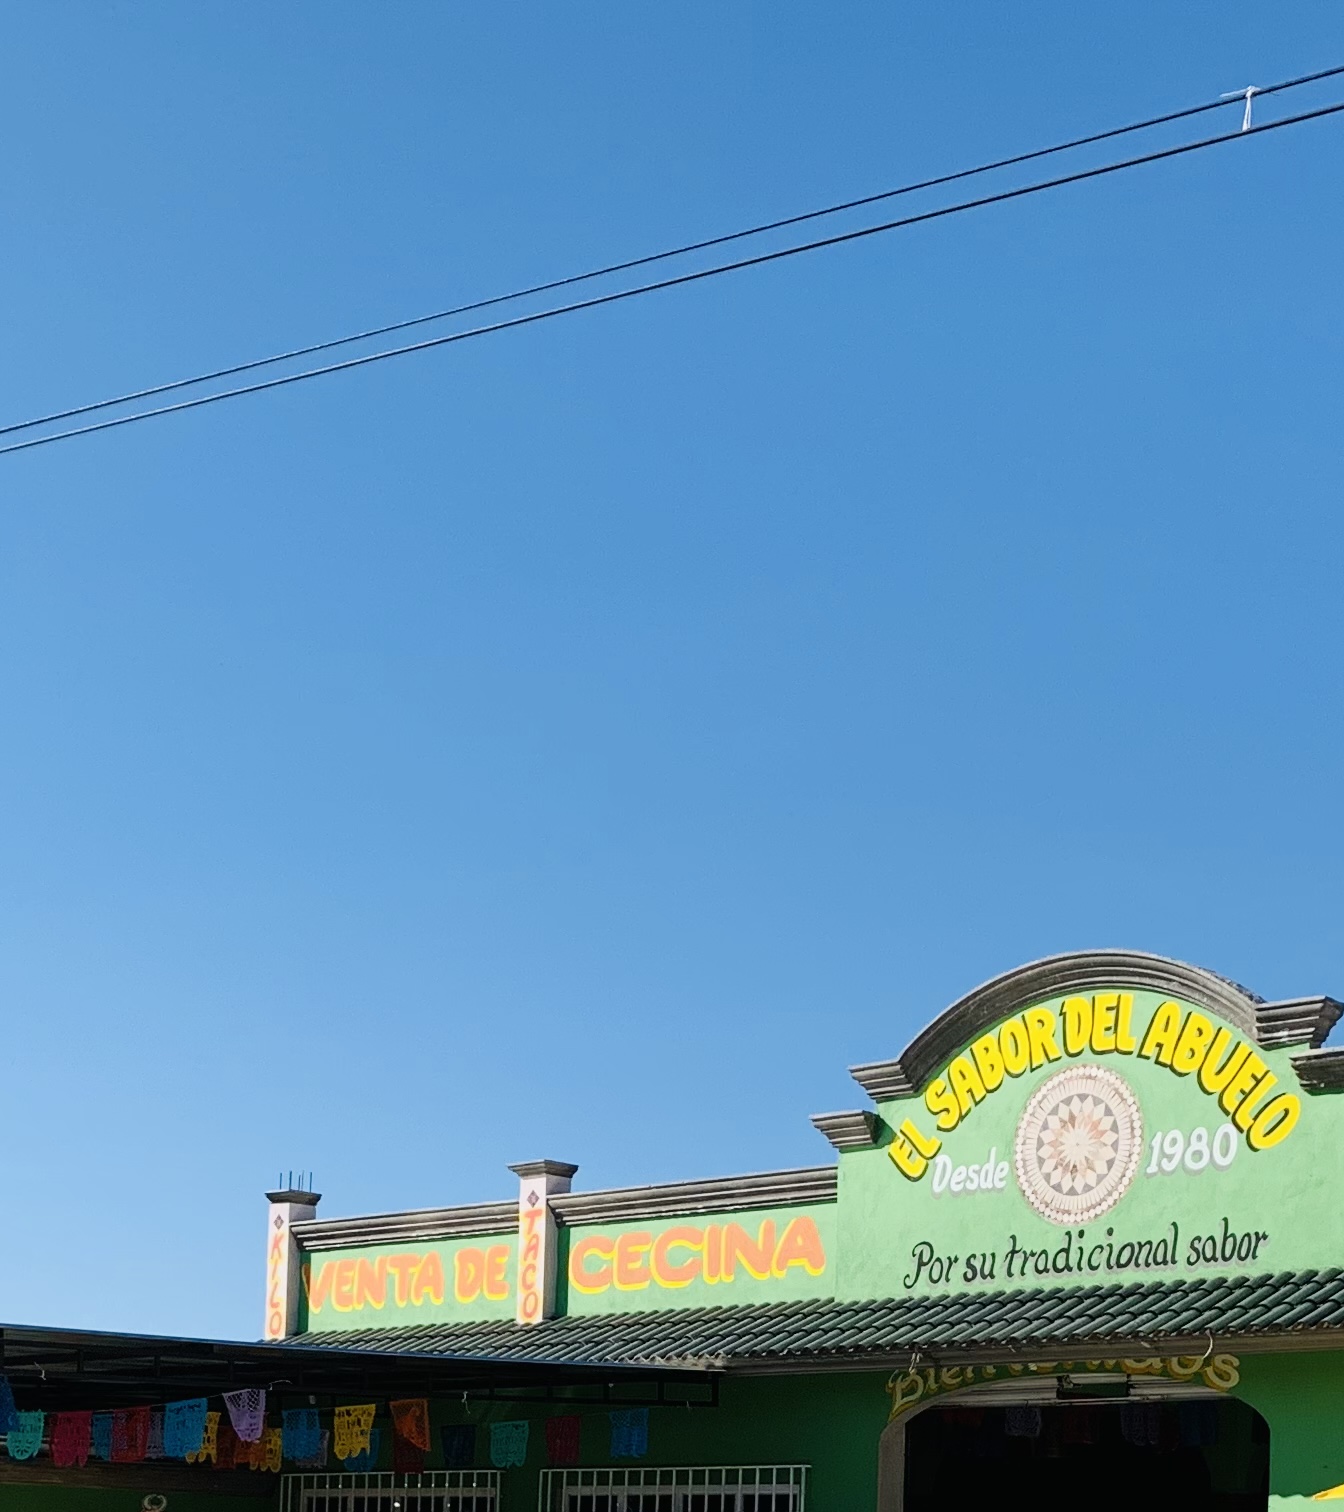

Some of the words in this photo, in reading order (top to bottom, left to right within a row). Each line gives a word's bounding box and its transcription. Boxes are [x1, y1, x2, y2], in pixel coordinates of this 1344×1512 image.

[888, 1117, 942, 1182] EL
[925, 1007, 1062, 1132] SABOR
[1059, 992, 1137, 1058] DEL
[1136, 1000, 1301, 1153] ABUELO
[931, 1147, 1010, 1195] Desde
[1146, 1122, 1238, 1174] 1980
[268, 1232, 286, 1337] KILO
[301, 1251, 445, 1314] VENTA
[454, 1244, 511, 1304] DE
[520, 1208, 544, 1319] TACO
[568, 1215, 827, 1295] CECINA
[903, 1240, 959, 1289] Por
[963, 1252, 997, 1283] su
[1004, 1221, 1179, 1278] tradicional
[1186, 1216, 1268, 1267] sabor
